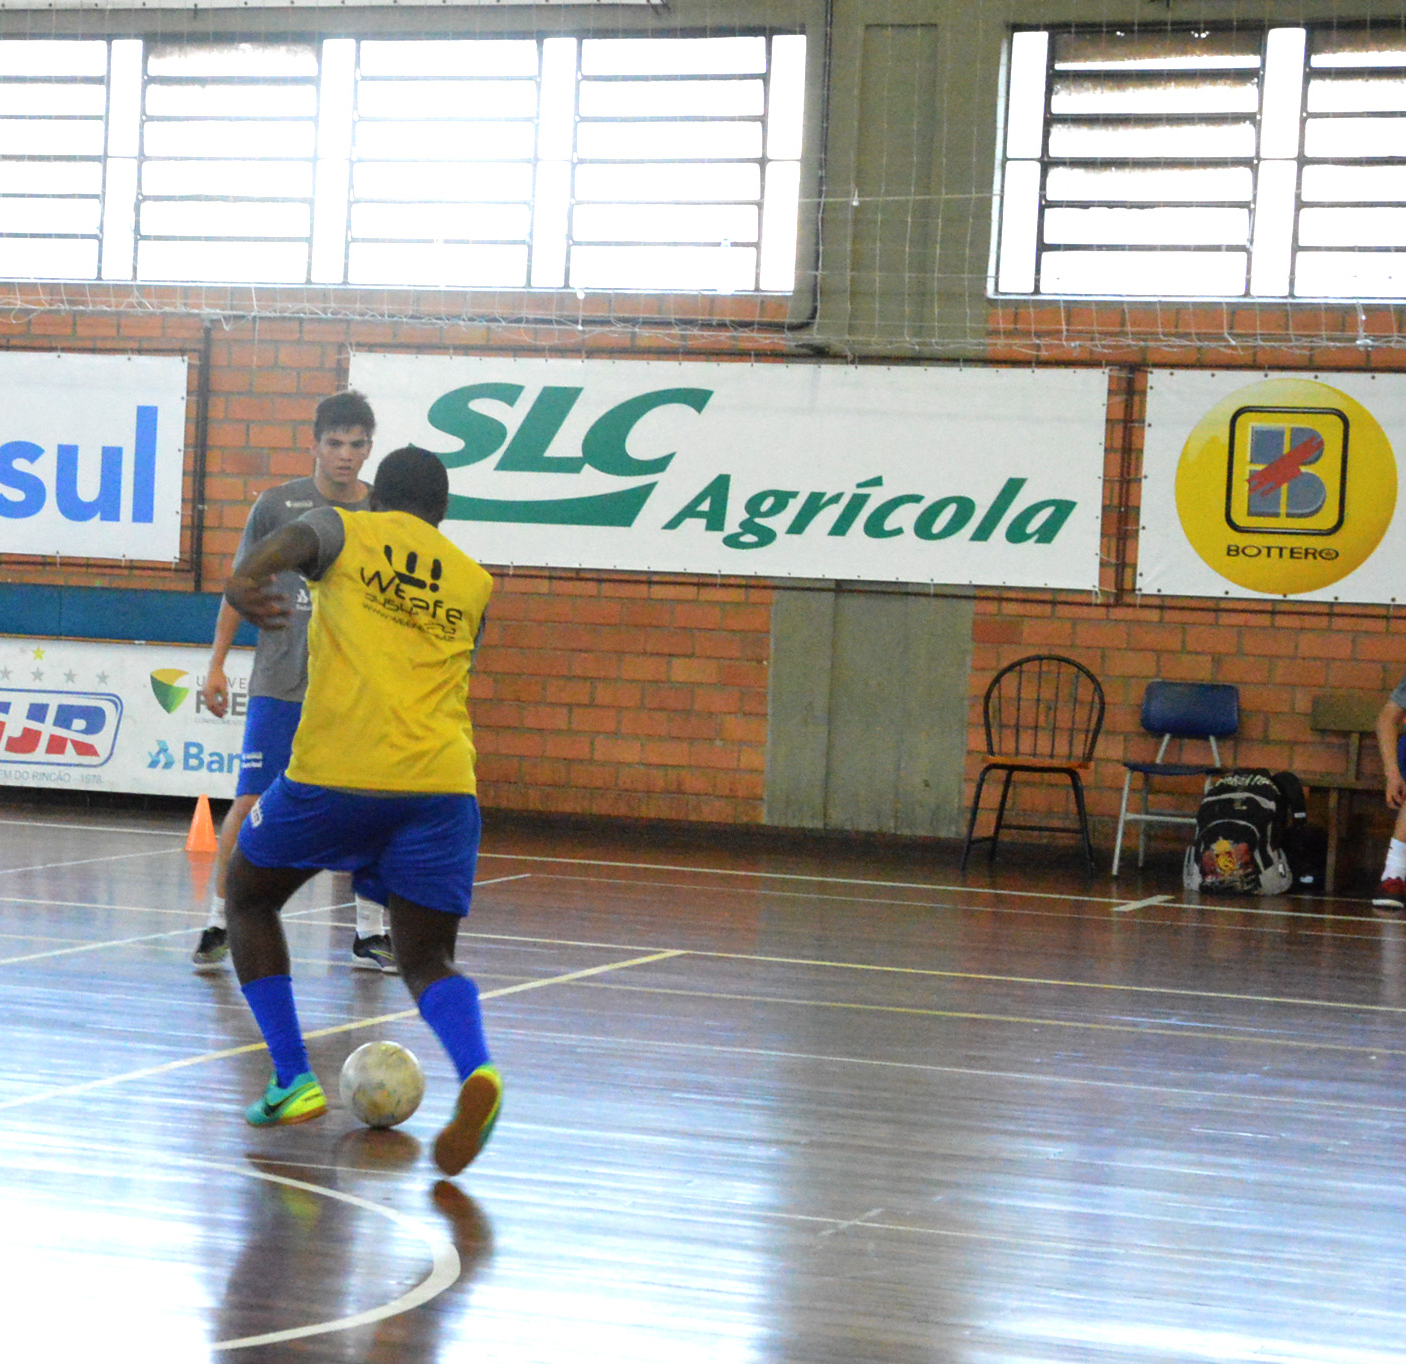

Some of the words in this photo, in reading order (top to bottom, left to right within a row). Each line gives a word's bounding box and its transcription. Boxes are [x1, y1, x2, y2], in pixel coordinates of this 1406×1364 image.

[408, 382, 714, 476] SLC
[662, 475, 1078, 550] Agrícola
[1226, 544, 1340, 561] BOTTERO
[183, 741, 242, 774] Ban
[14, 770, 30, 781] DO
